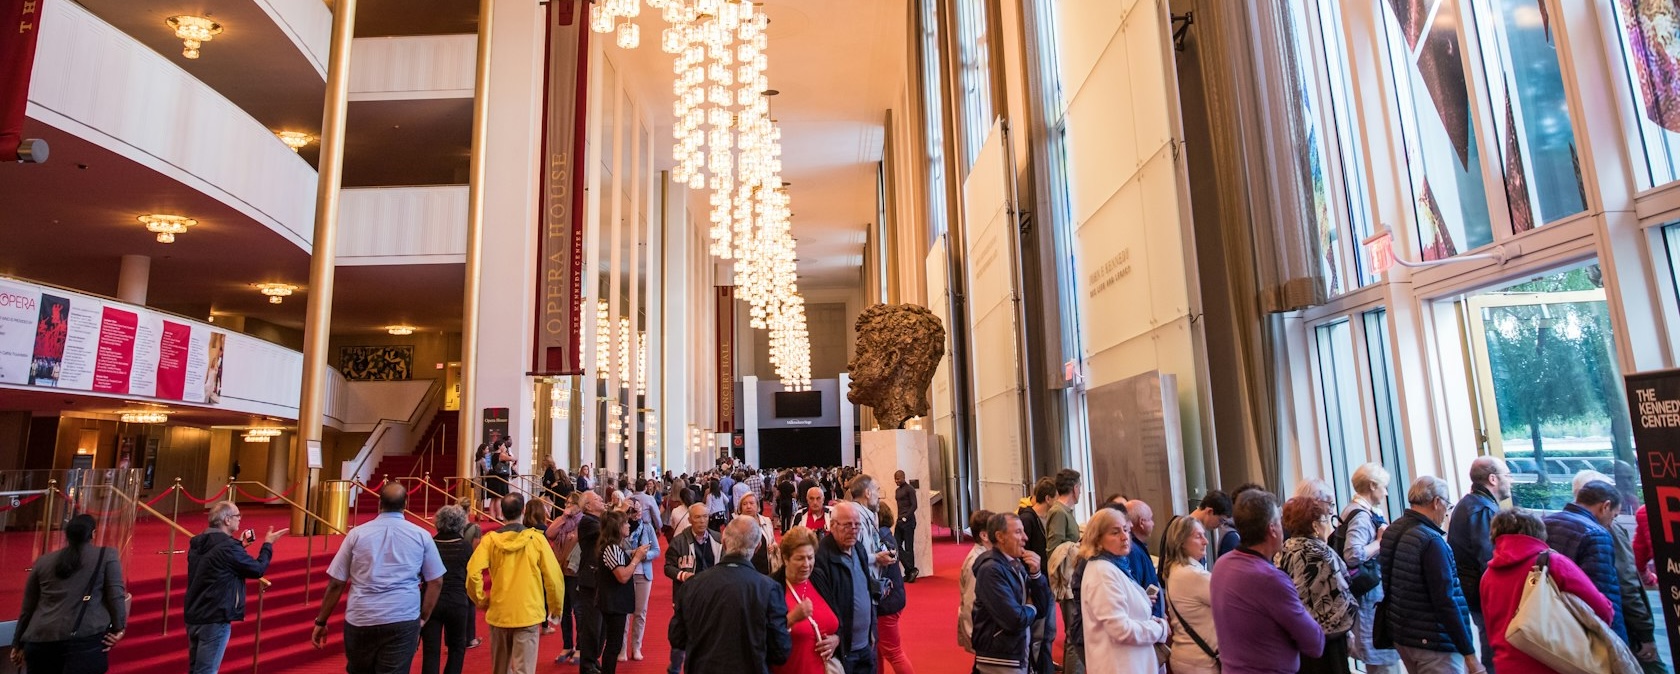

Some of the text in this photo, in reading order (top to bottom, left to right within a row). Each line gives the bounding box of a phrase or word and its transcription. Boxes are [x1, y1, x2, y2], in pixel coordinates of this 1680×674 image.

[546, 152, 567, 334] OPERA HOUSE
[1636, 388, 1656, 402] THE
[1641, 413, 1680, 428] CENTER
